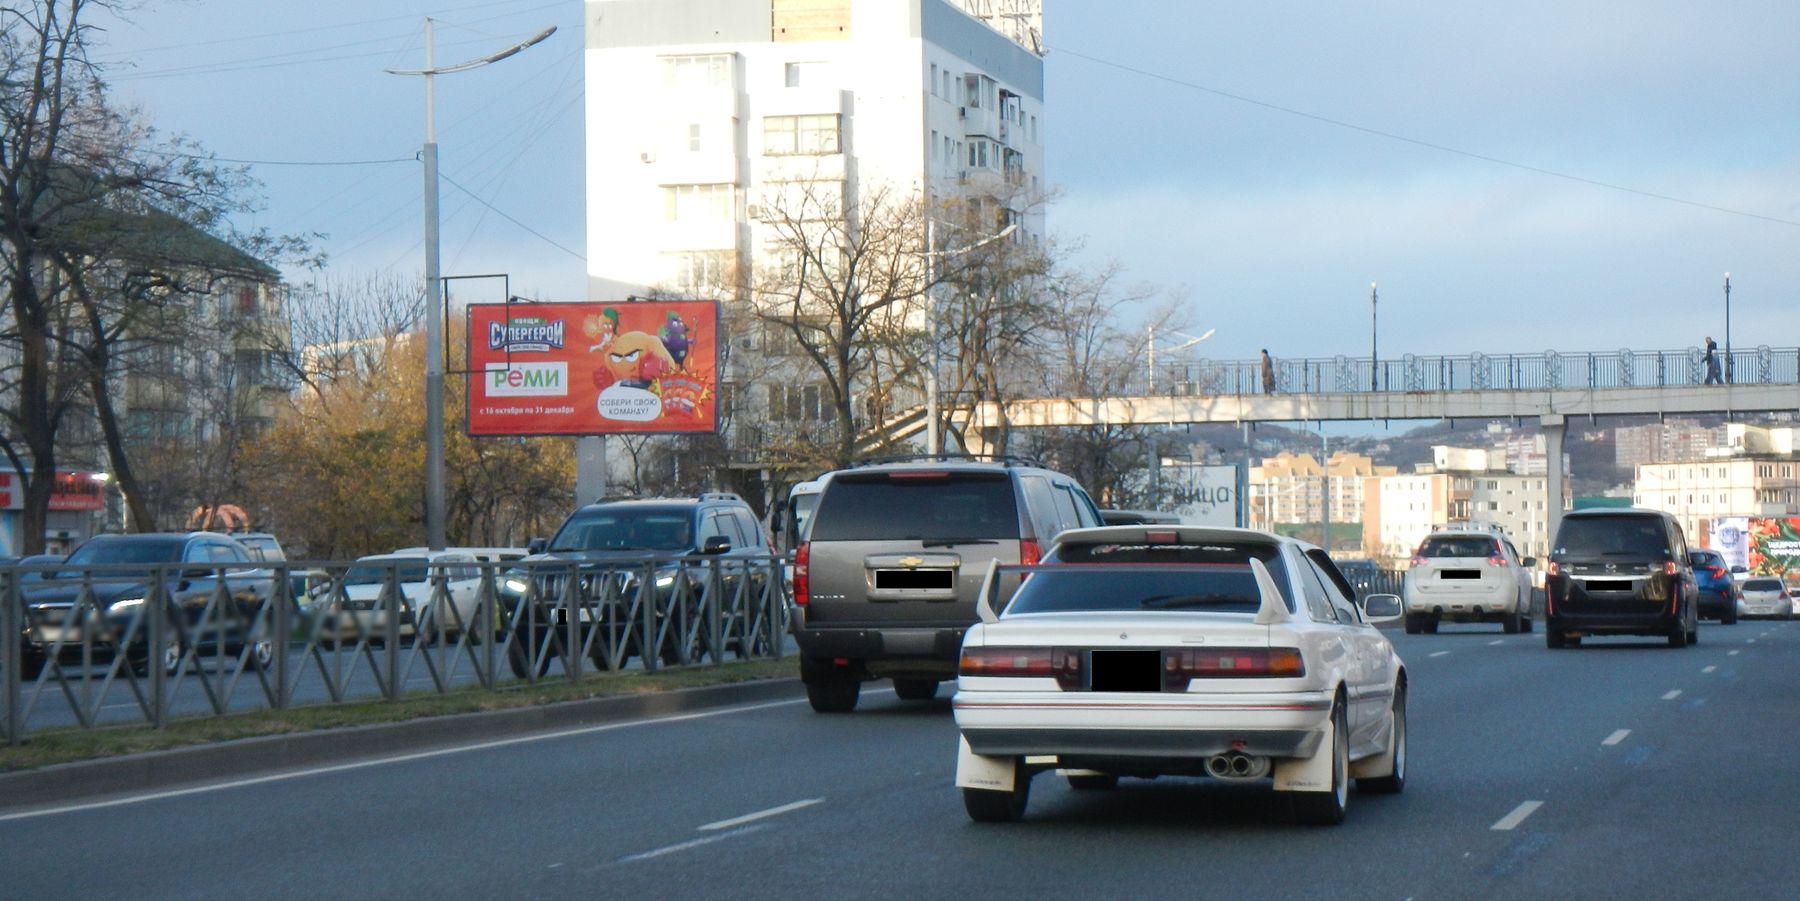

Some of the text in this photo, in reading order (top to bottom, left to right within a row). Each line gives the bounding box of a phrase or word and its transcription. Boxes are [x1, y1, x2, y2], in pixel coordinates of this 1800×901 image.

[490, 320, 563, 347] СУПЕРГЕРОИ
[600, 398, 658, 407] СОБЕРИ СВОЮ
[495, 406, 524, 416] октября
[536, 406, 543, 414] 31
[544, 406, 576, 415] декабря
